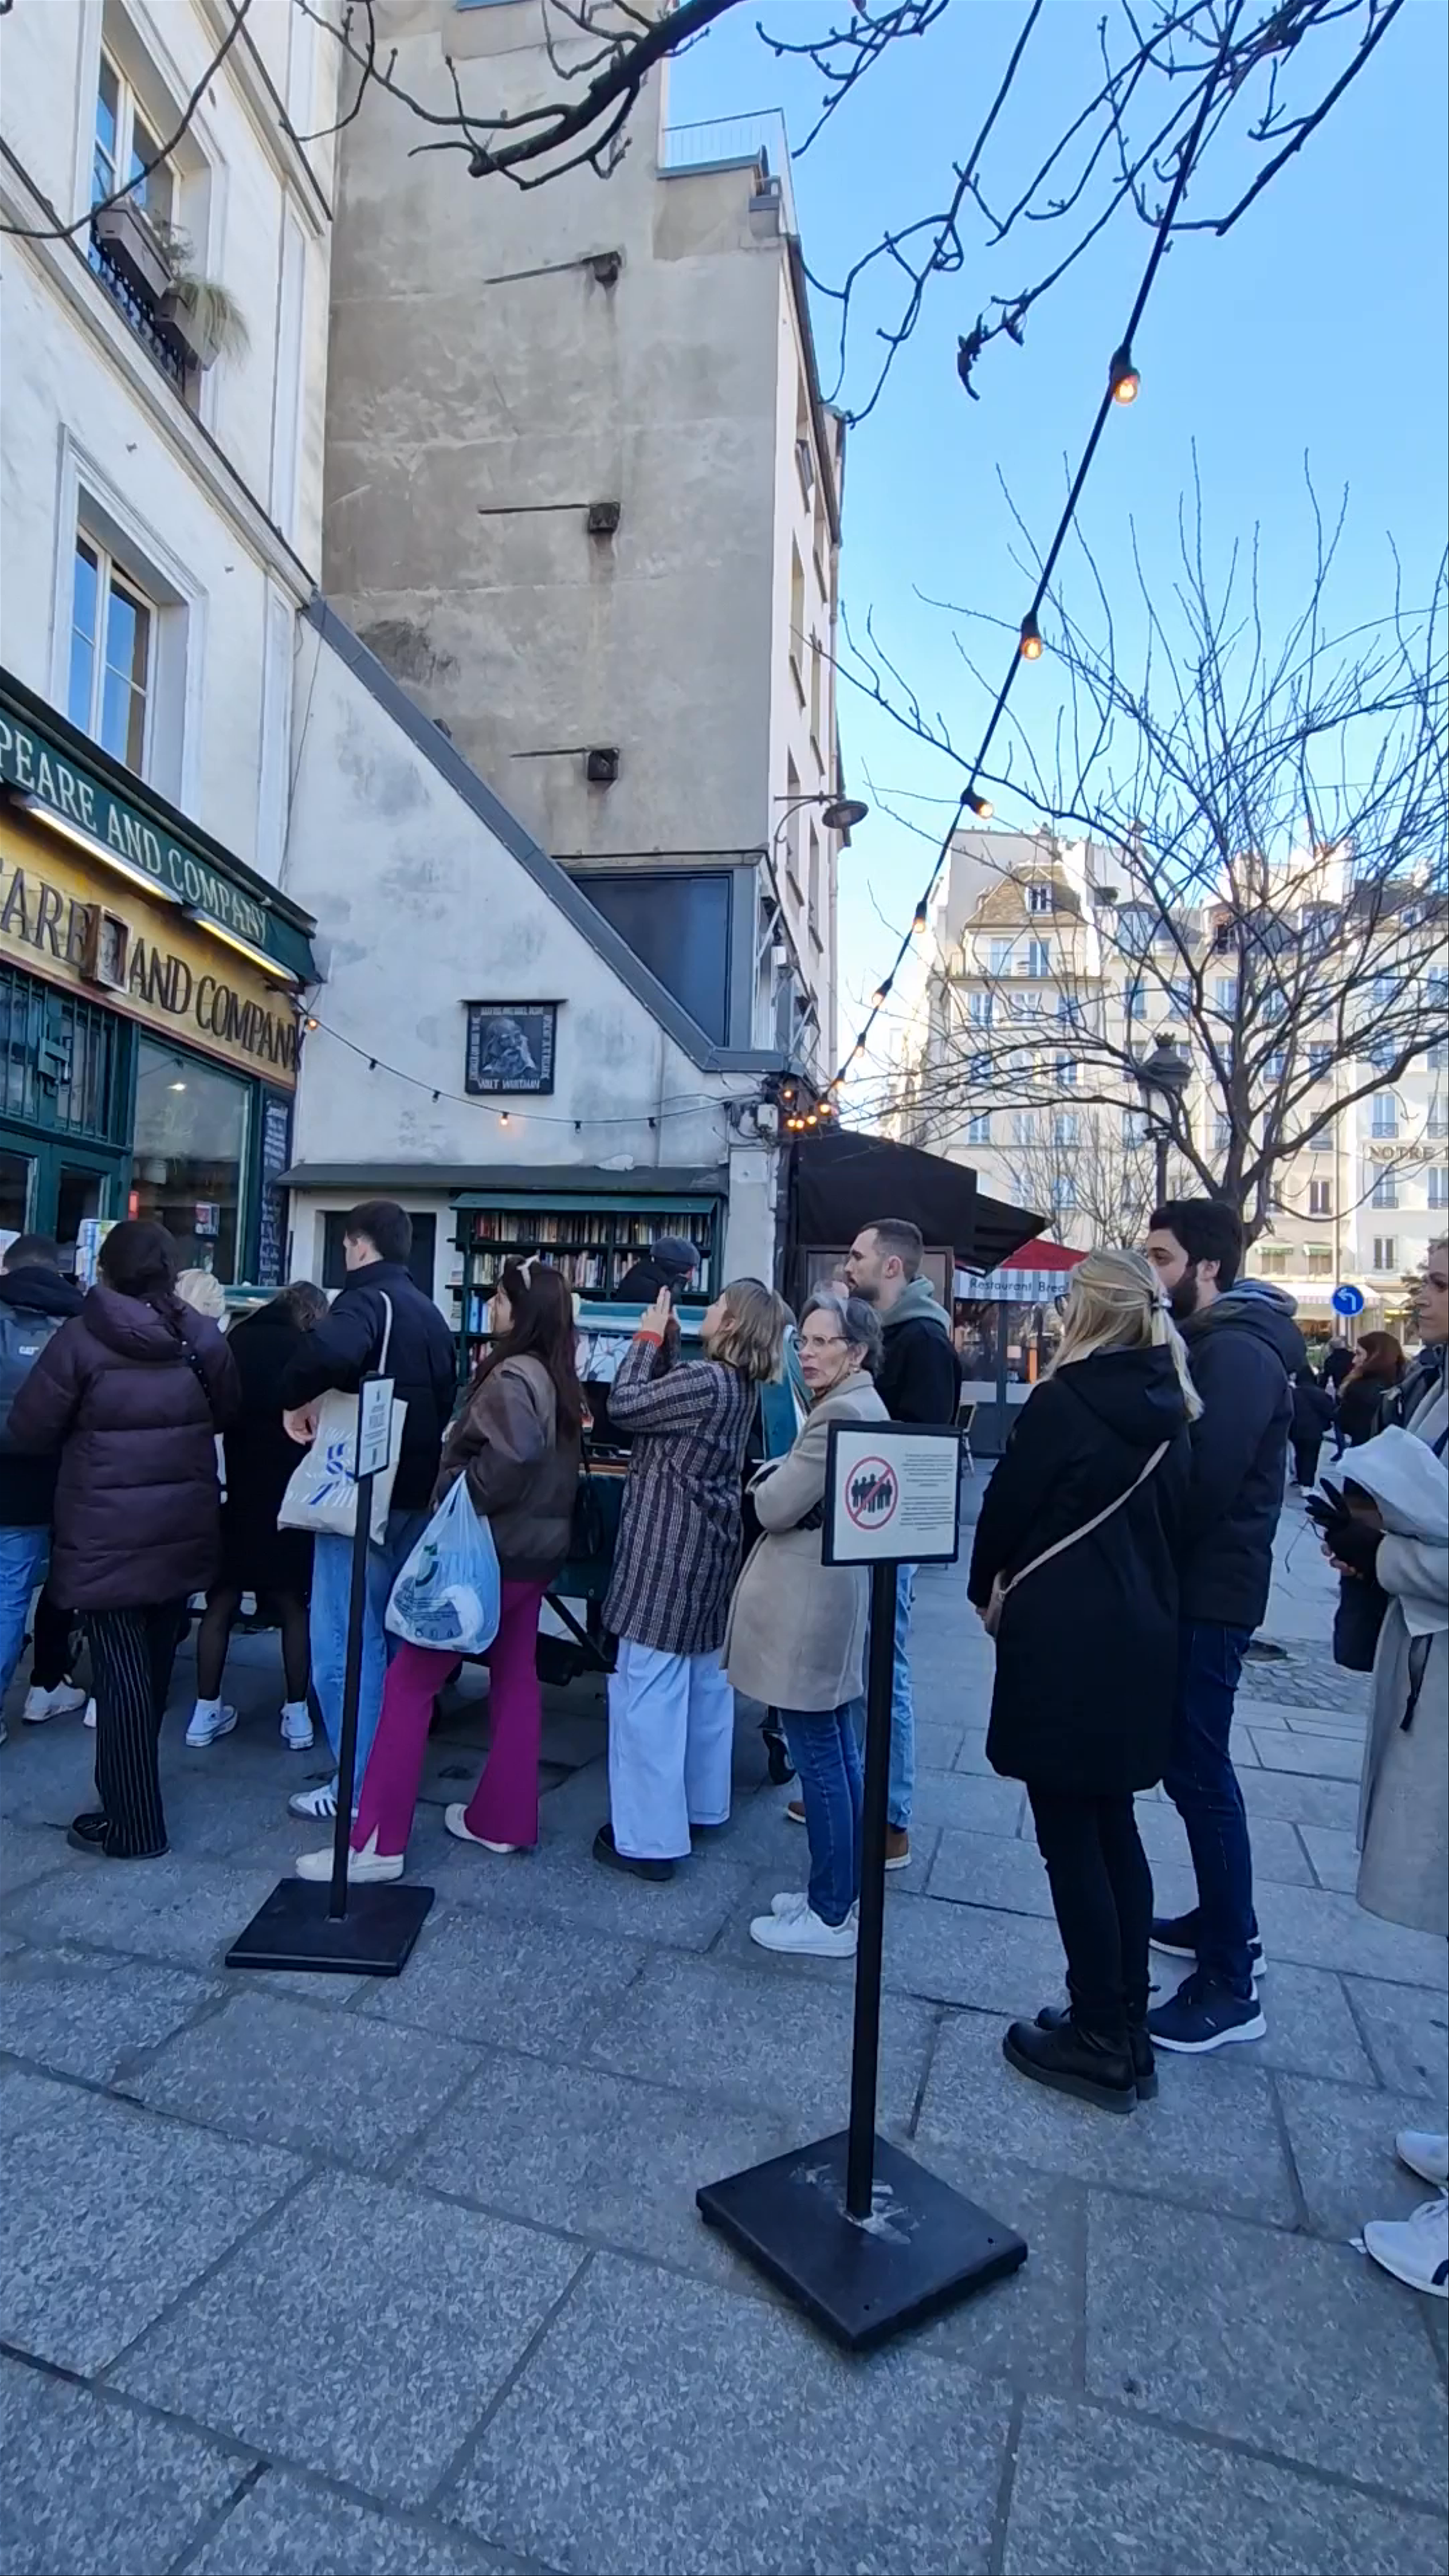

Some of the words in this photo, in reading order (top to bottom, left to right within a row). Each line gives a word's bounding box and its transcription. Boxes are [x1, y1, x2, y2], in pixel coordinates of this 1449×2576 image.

[107, 804, 162, 875] AND
[168, 849, 266, 944] COMPANY
[129, 937, 192, 1014] AND
[1369, 1146, 1437, 1161] NOTRE
[969, 1278, 1031, 1291] Restaurant
